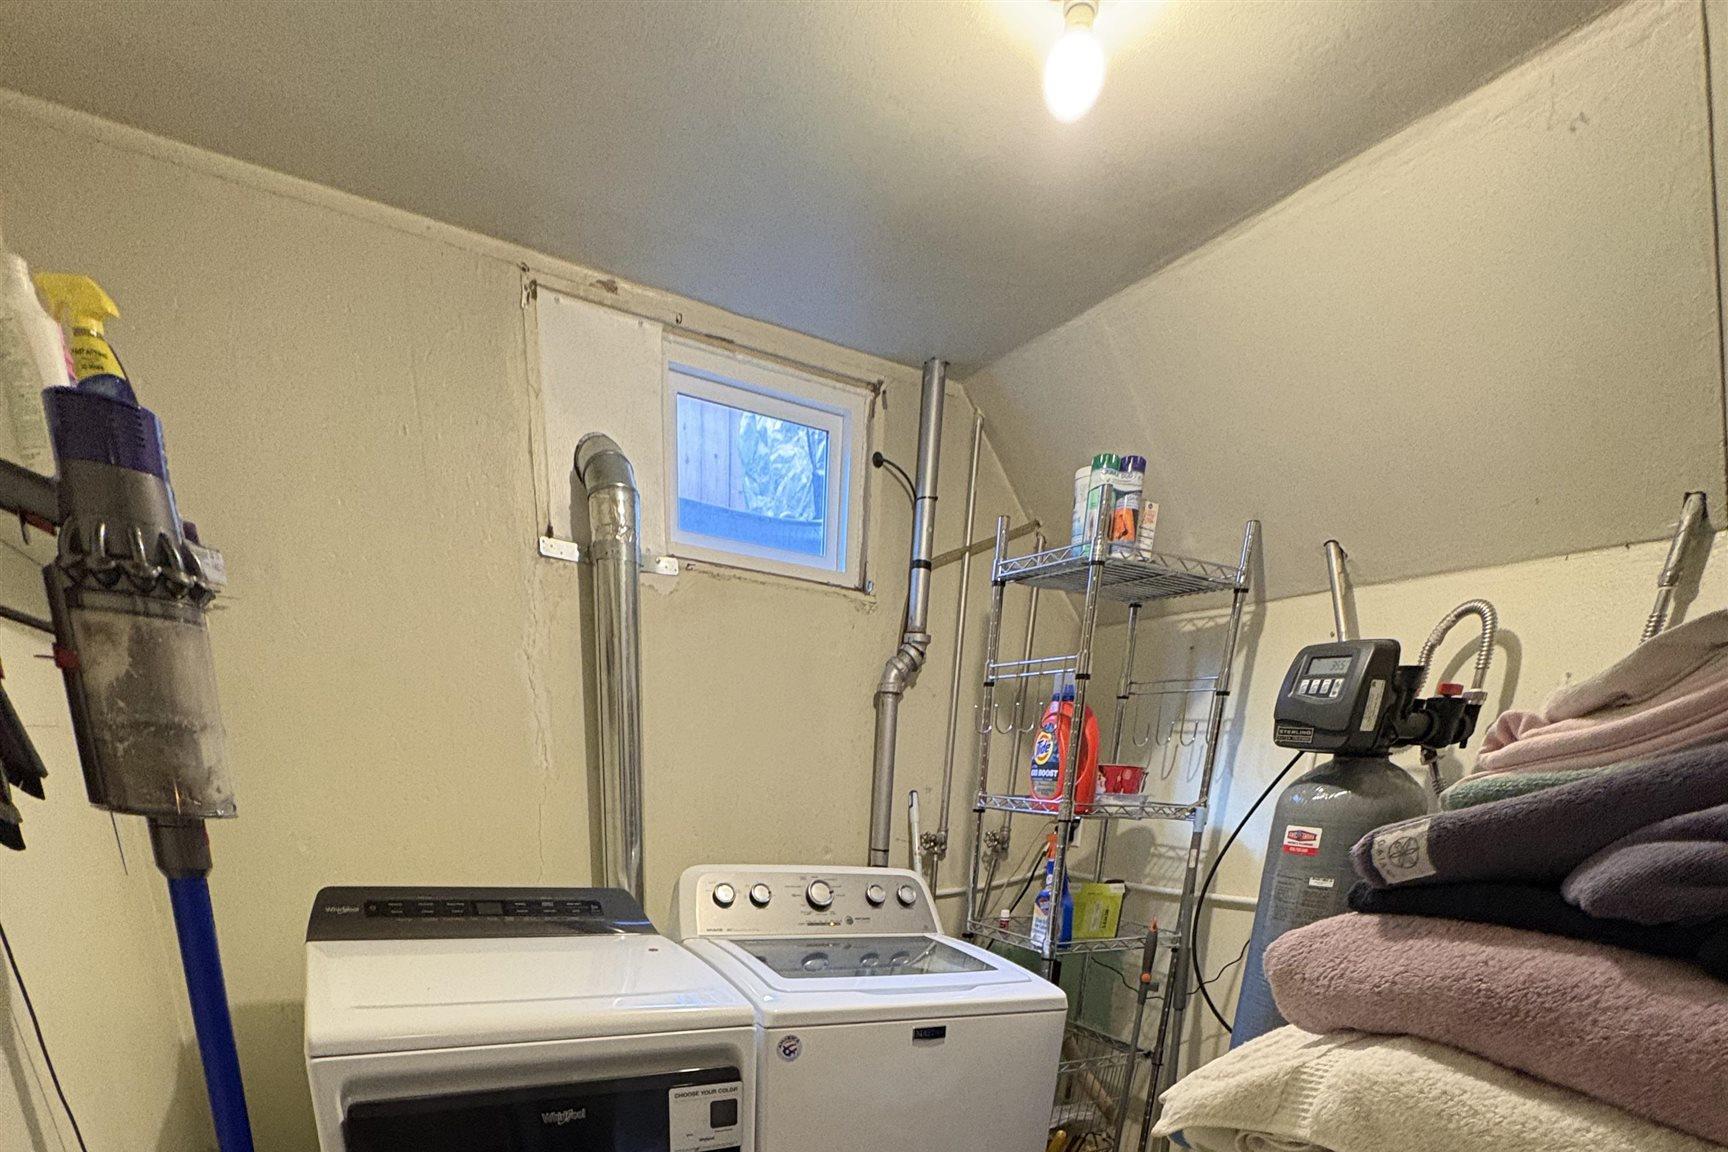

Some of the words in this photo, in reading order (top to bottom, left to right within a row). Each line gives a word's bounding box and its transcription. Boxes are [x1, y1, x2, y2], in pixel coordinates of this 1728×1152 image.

[1036, 738, 1052, 755] Tide
[1038, 769, 1058, 777] BOOST
[674, 1091, 699, 1099] CHOOSE
[701, 1088, 717, 1096] YOUR
[718, 1086, 738, 1094] COLOR
